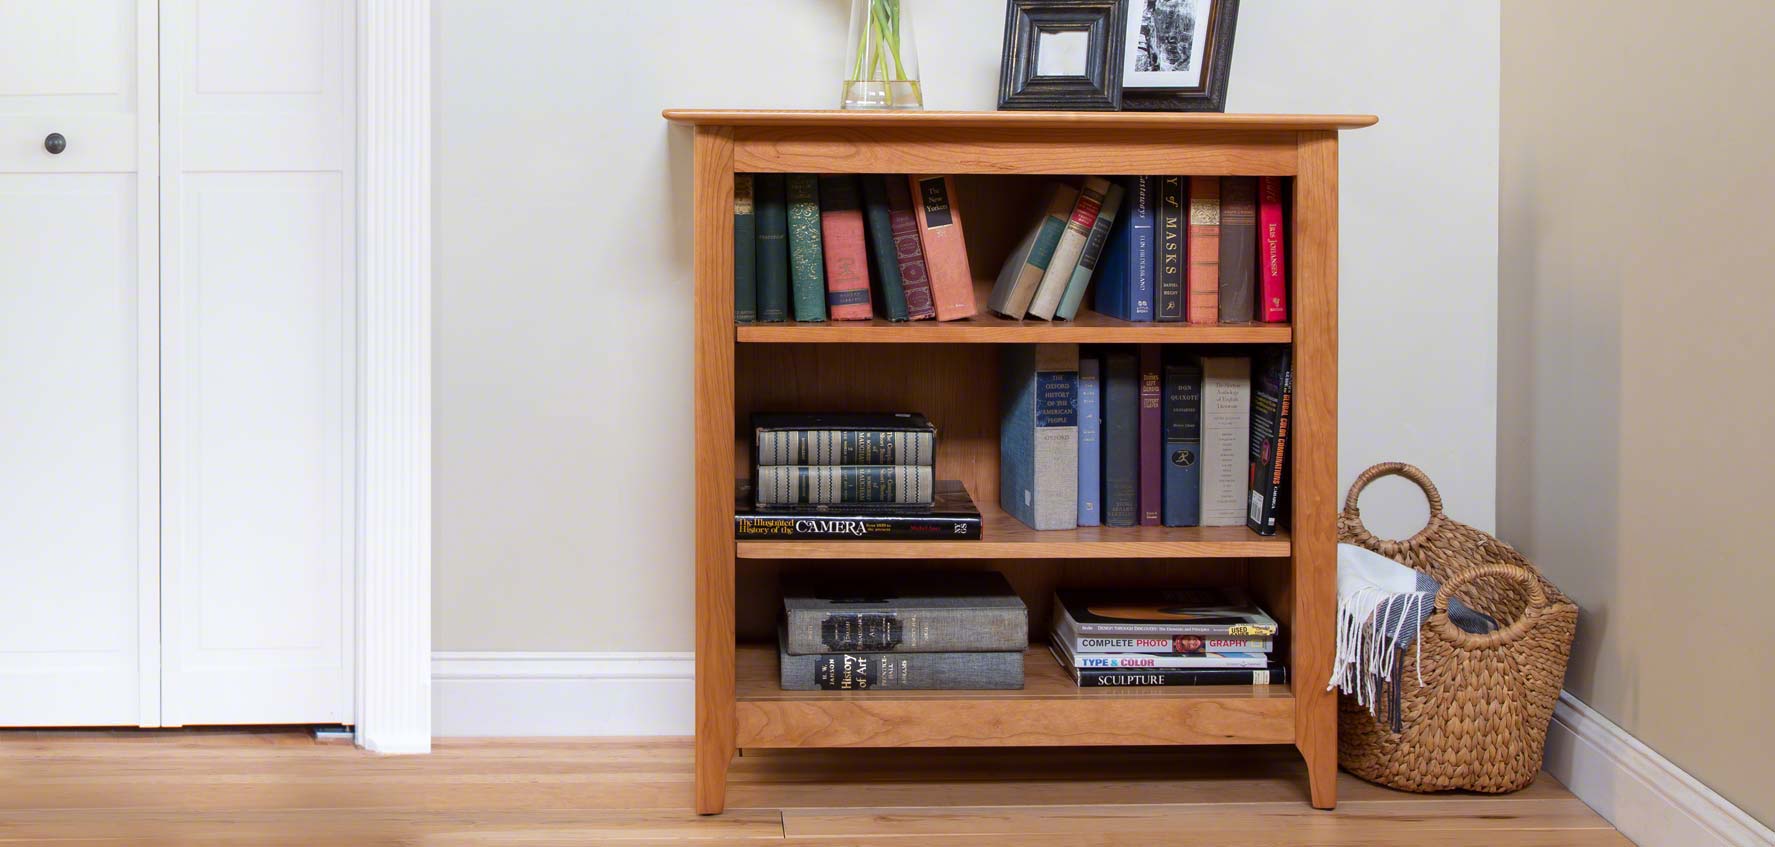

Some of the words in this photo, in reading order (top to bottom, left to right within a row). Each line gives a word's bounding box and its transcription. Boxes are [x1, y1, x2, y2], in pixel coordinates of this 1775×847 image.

[1137, 175, 1147, 218] astaways
[1165, 195, 1179, 208] of
[1165, 217, 1177, 274] MASKS
[739, 518, 753, 527] The
[795, 519, 868, 536] CAMERA
[739, 526, 769, 535] History
[781, 526, 794, 535] the
[1231, 626, 1248, 634] USED
[1082, 639, 1134, 647] COMPLETE
[1136, 639, 1168, 647] PHOTO
[1209, 639, 1248, 647] GRAPHY
[857, 656, 867, 676] Art
[1082, 658, 1109, 667] TYPE
[1110, 658, 1118, 667] &
[1120, 658, 1155, 667] COLOR
[841, 654, 856, 689] History
[856, 677, 867, 689] of
[1098, 675, 1166, 686] SCULPTURE
